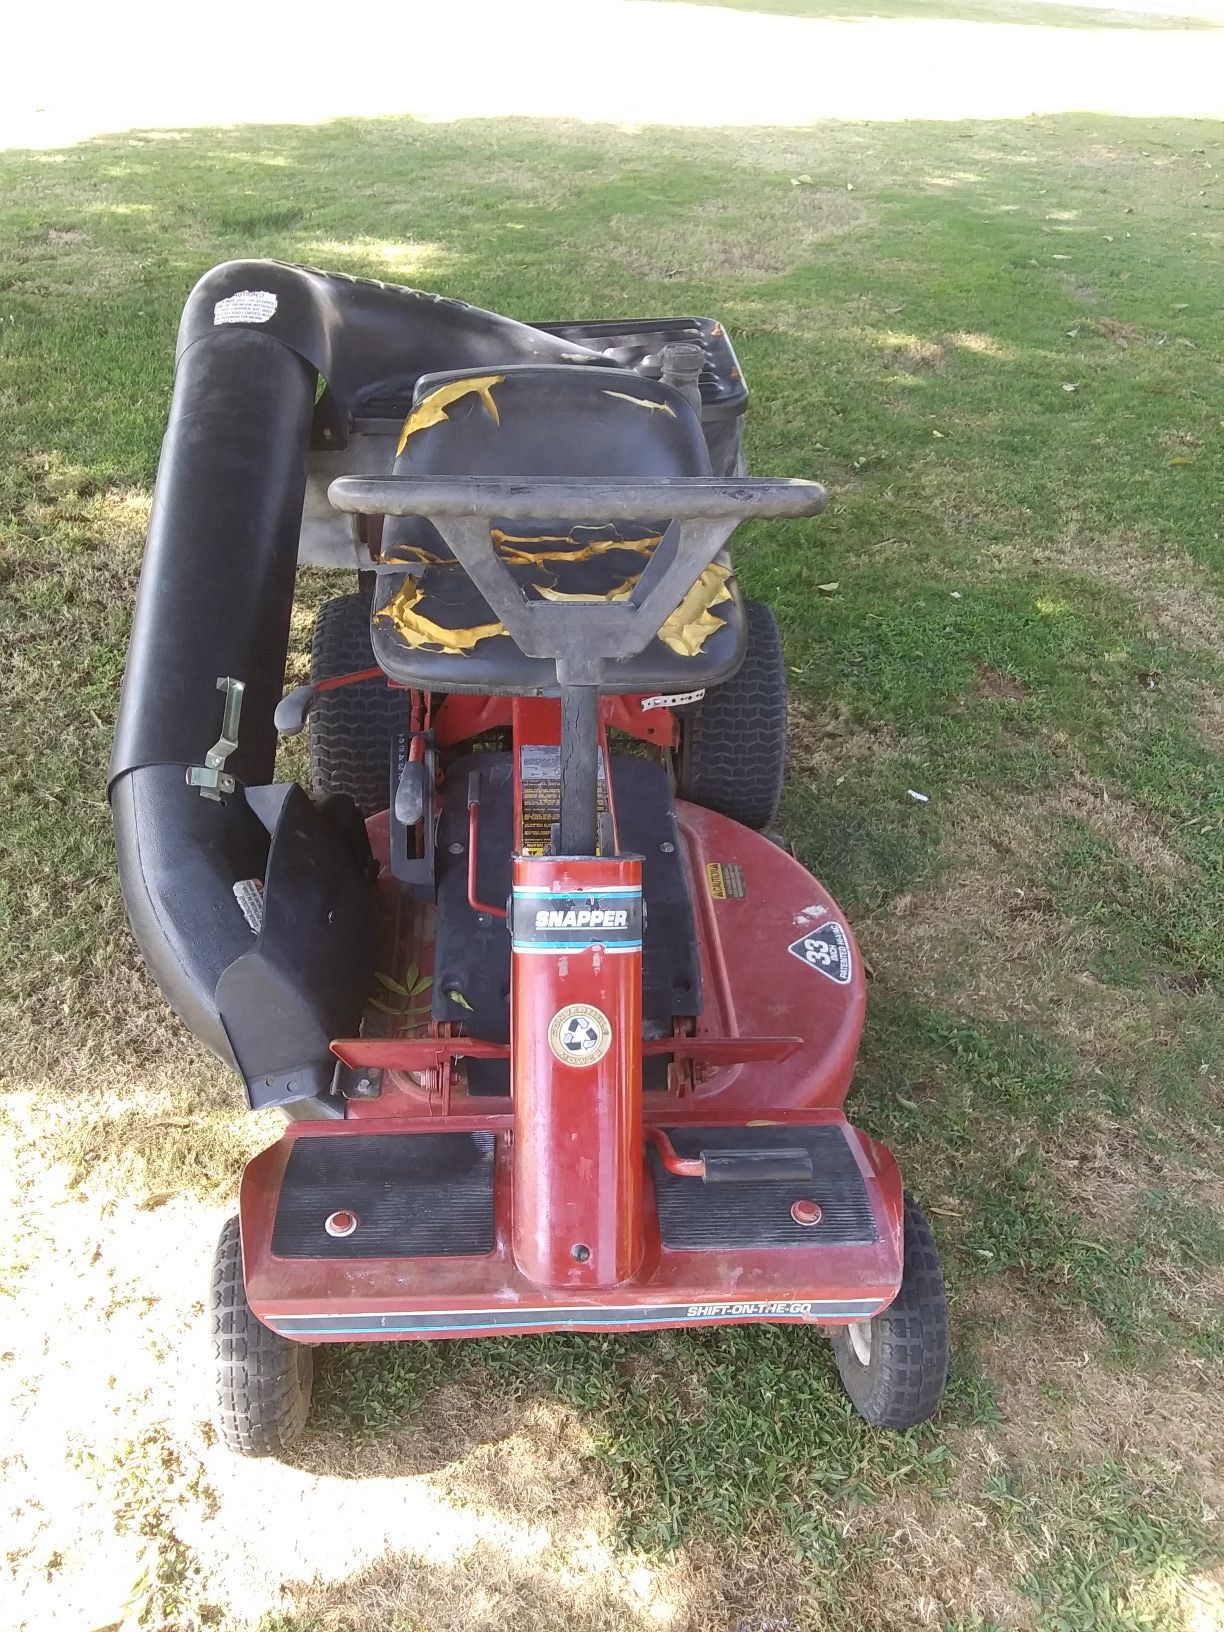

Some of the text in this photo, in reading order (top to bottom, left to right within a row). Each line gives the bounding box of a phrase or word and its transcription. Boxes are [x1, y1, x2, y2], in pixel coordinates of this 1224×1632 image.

[535, 910, 628, 927] SNAPPER
[804, 938, 831, 966] 33
[828, 944, 839, 962] INCH
[838, 946, 848, 979] PATENTED
[686, 1303, 813, 1317] SHIFT-ON-THE-GO
